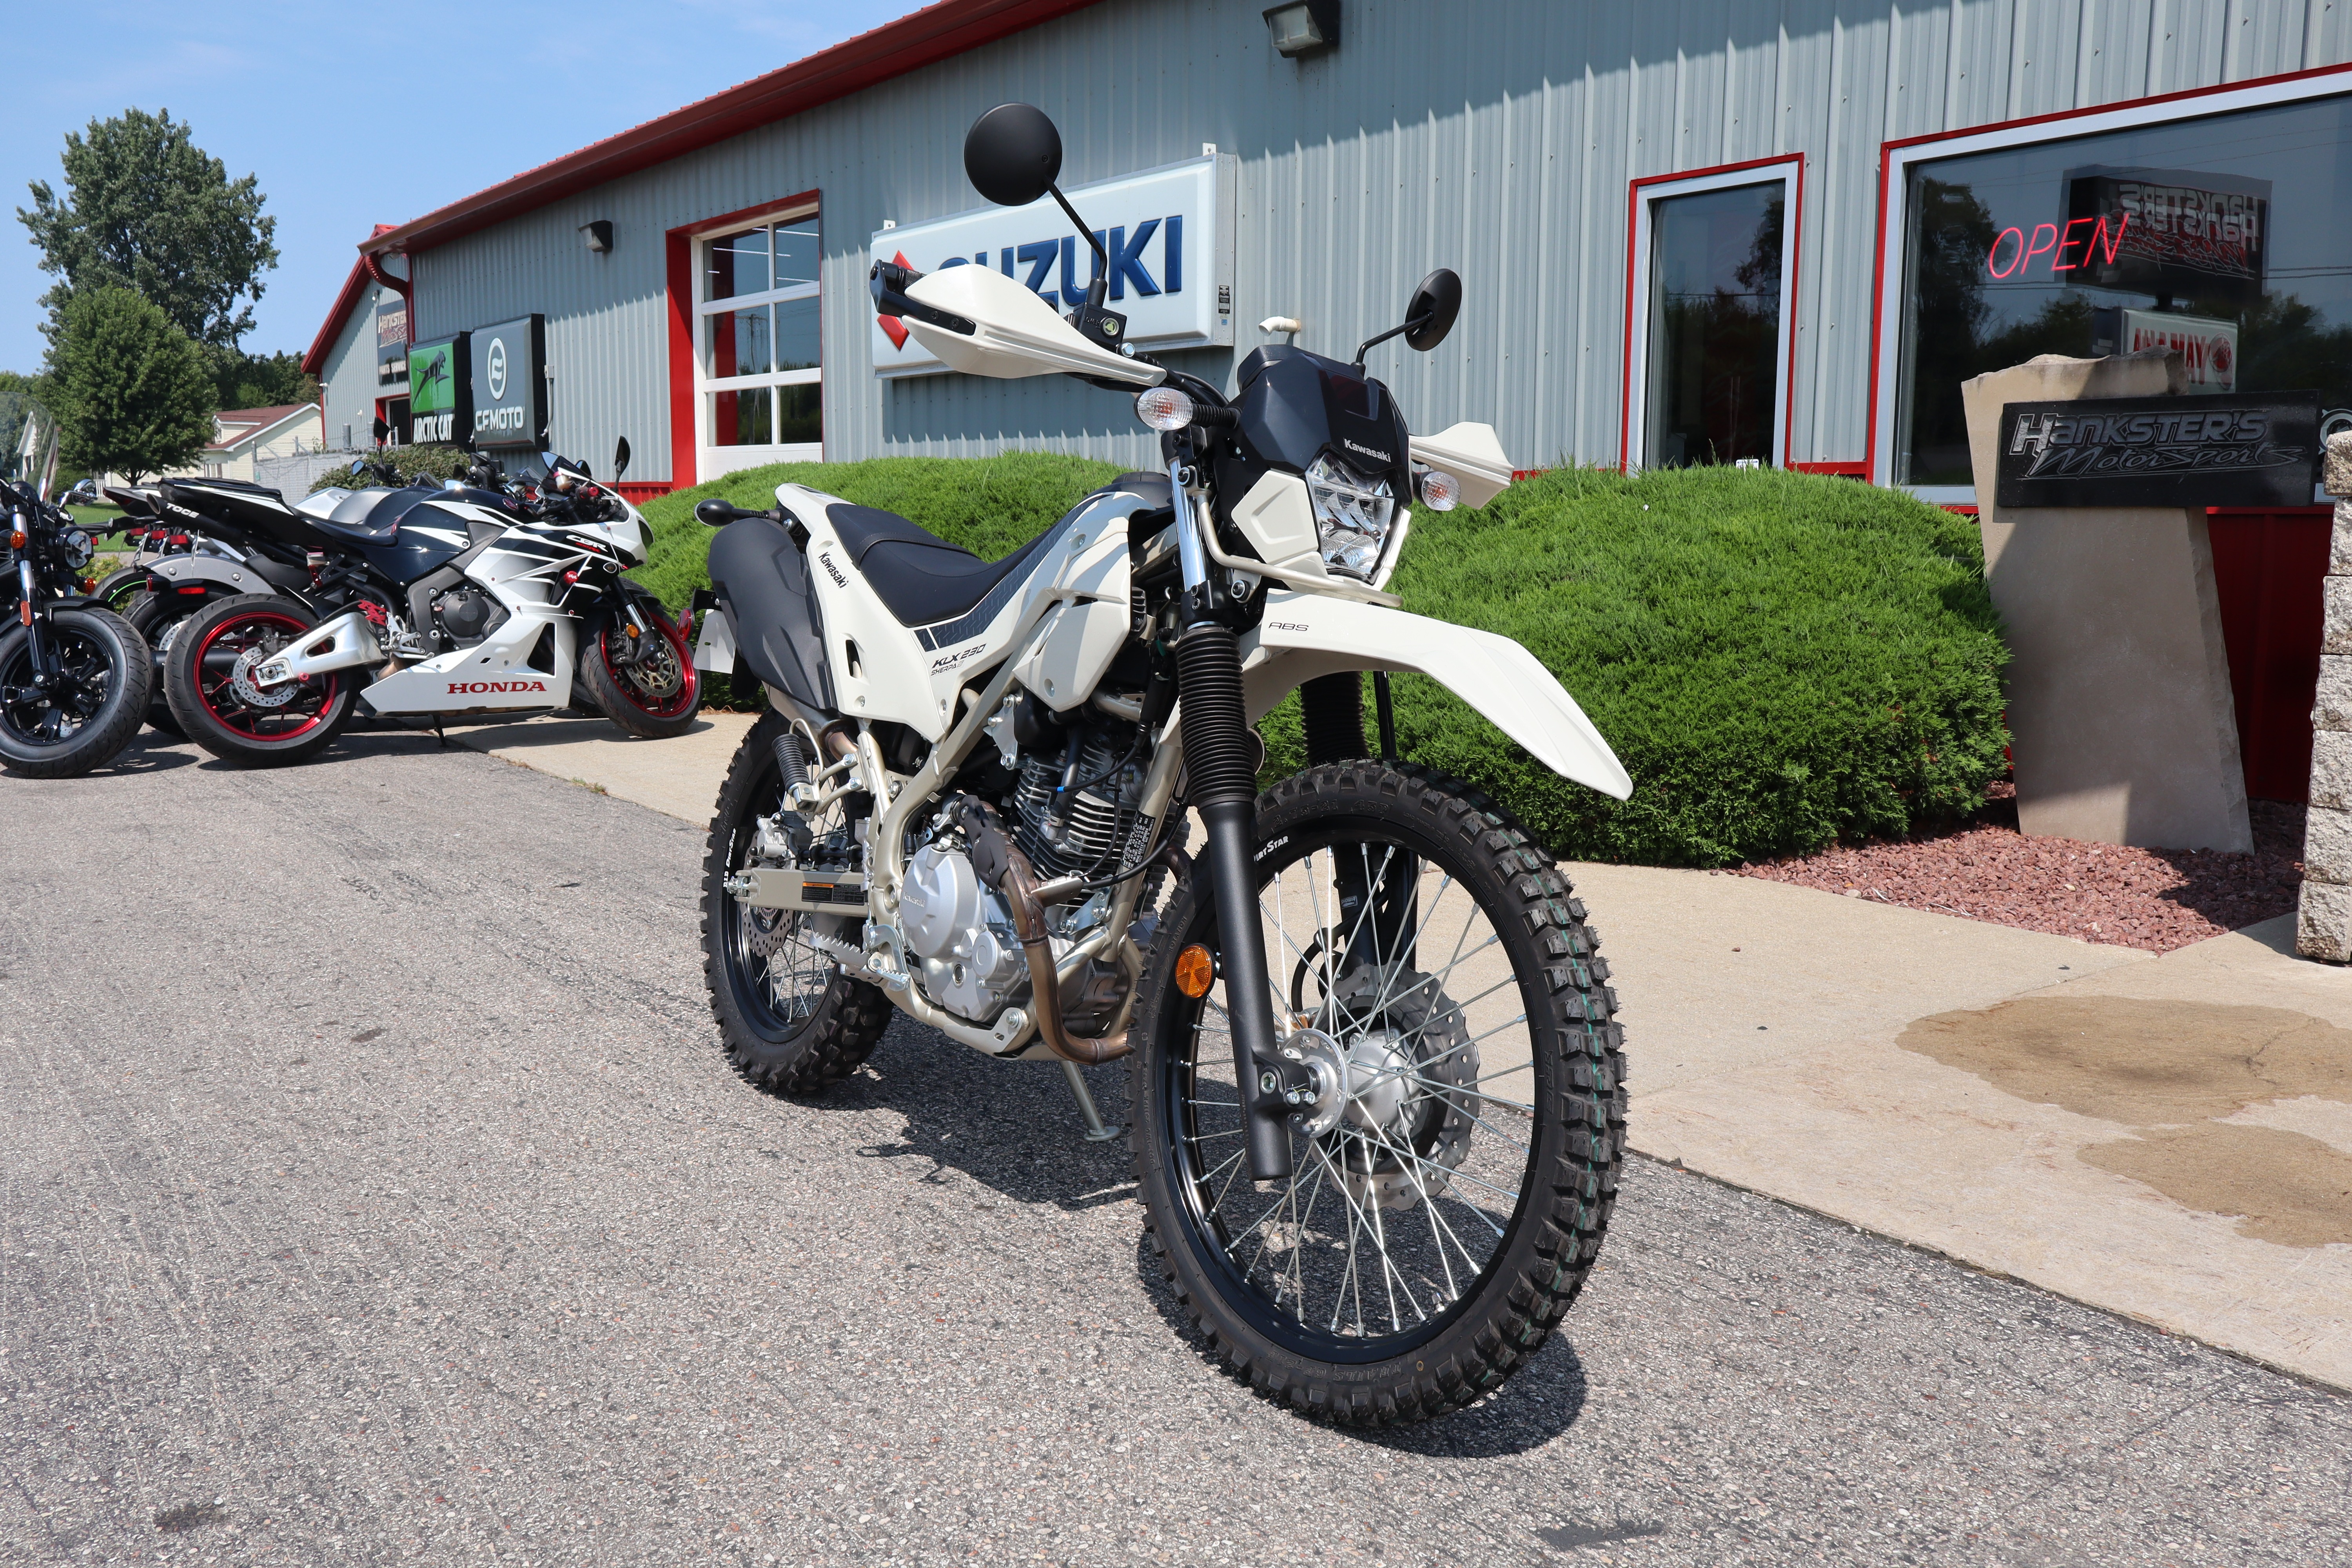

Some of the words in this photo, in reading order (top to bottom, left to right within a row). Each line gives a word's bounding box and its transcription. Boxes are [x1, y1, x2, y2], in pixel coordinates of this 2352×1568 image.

[1988, 213, 2130, 279] OPEN
[938, 214, 1182, 307] ZUKI
[379, 364, 390, 375] PARTS
[413, 416, 437, 443] ARCTIC
[438, 414, 454, 441] CAT
[475, 406, 524, 432] CFMOTO
[2009, 409, 2270, 456] HanKSTER'S
[1344, 438, 1391, 463] Kawasaki
[166, 503, 200, 518] TOCE
[566, 535, 608, 552] CBR
[818, 552, 849, 588] Kawasaki
[1269, 622, 1309, 631] ABS
[932, 652, 961, 669] KLX
[960, 643, 987, 659] 230
[931, 663, 956, 676] SHERPA
[447, 682, 546, 693] HONDA
[1273, 799, 1338, 828] 2.75-21
[1354, 799, 1389, 814] 45P
[726, 828, 736, 867] DIRTSTAR
[903, 892, 925, 907] Kawasaki
[1169, 917, 1187, 952] ROTATION
[1266, 1350, 1326, 1379] GP-21F
[1333, 1362, 1401, 1382] TRAILS
